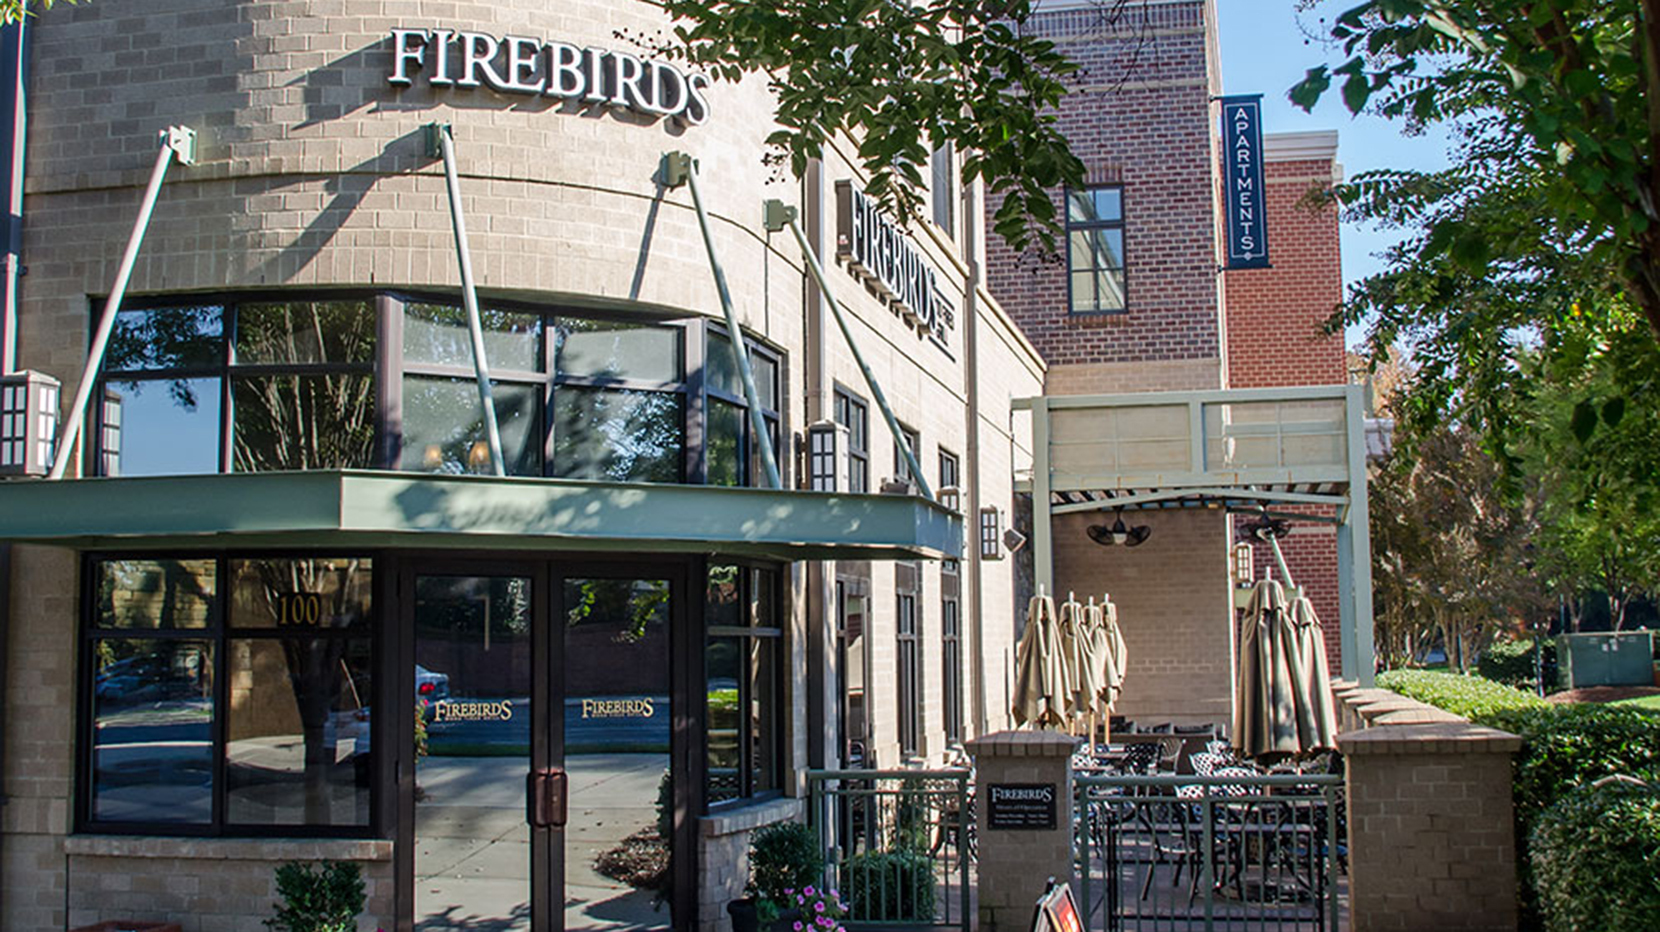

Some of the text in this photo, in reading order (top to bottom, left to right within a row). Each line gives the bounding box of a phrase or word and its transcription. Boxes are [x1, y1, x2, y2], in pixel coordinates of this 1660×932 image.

[387, 27, 710, 125] FIREBIRDS
[1234, 107, 1254, 250] APARTMENTS
[280, 595, 319, 624] 100
[434, 699, 512, 721] FIREBIRDS
[581, 697, 654, 718] FIREBIRDS
[991, 786, 1052, 802] FIREBIRDS
